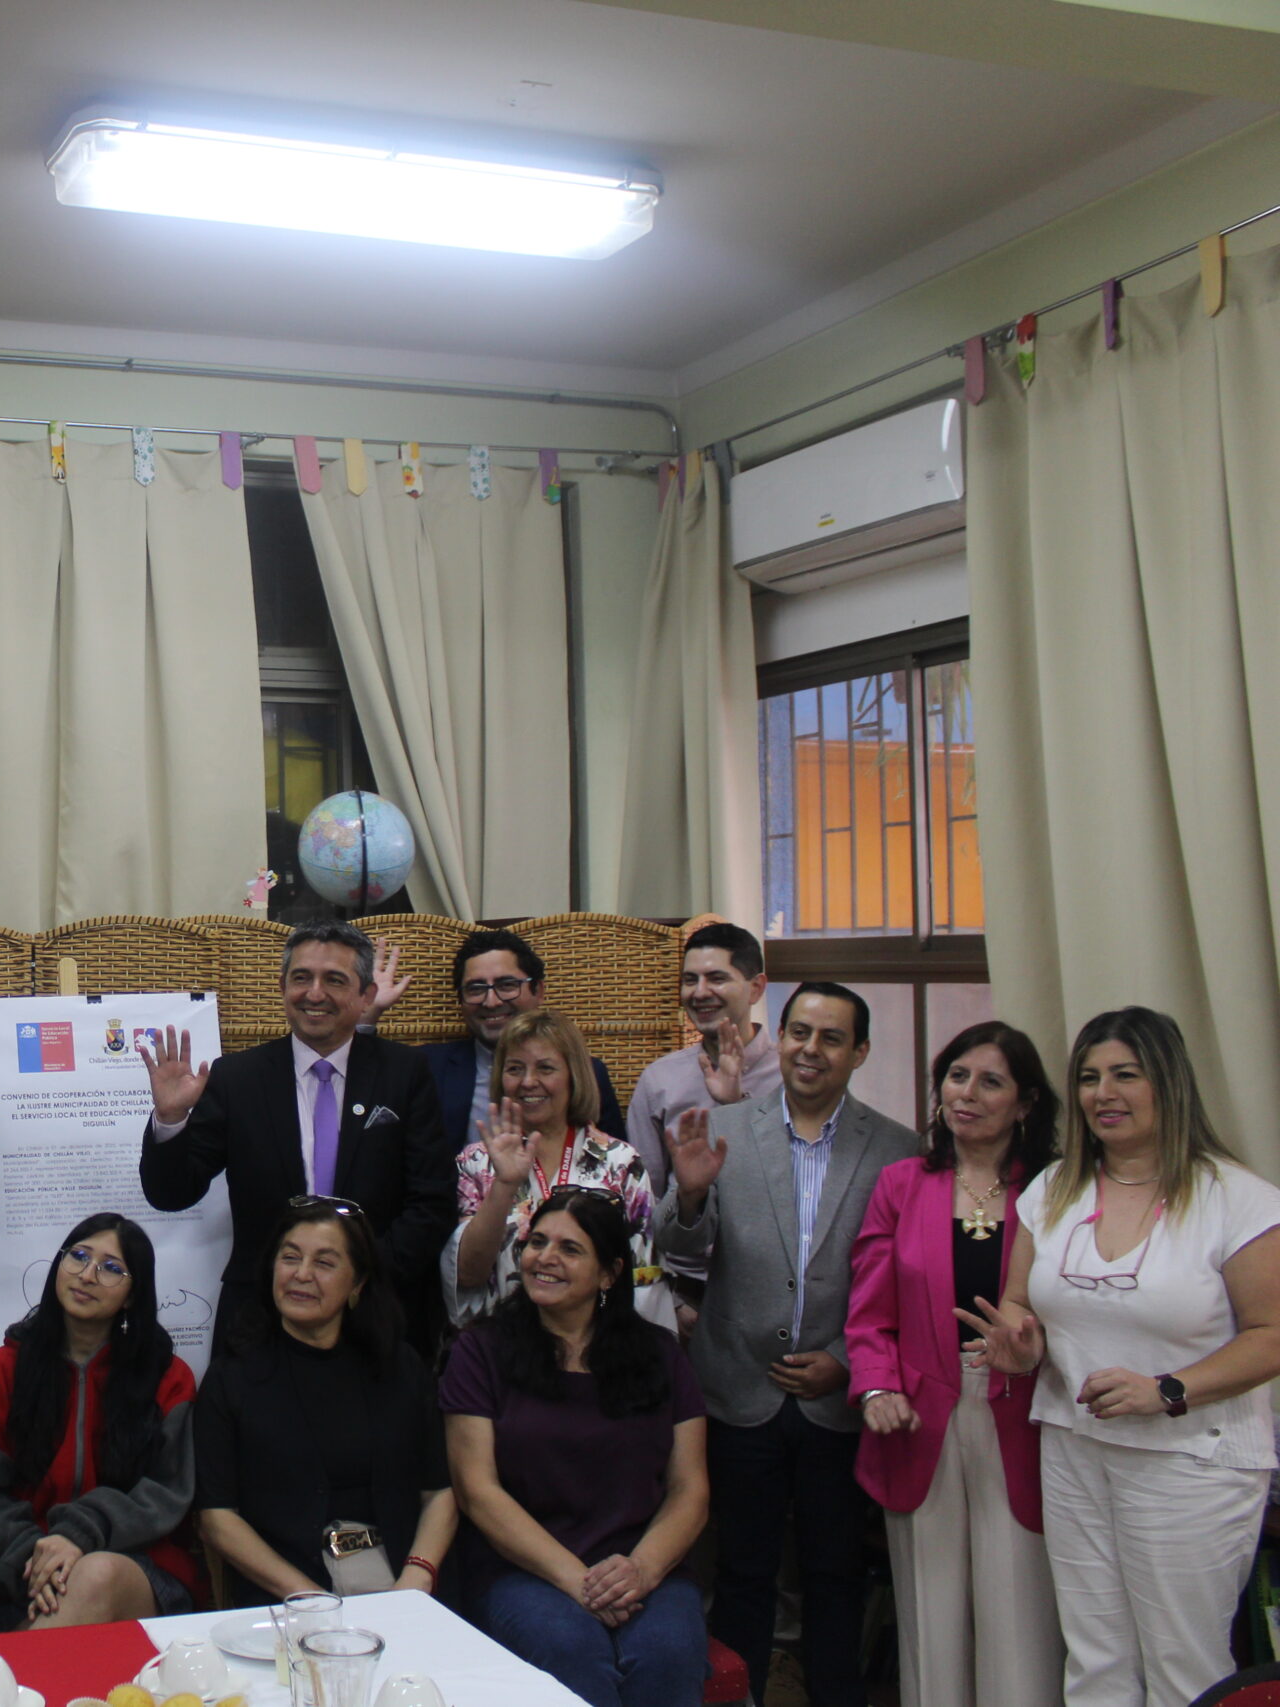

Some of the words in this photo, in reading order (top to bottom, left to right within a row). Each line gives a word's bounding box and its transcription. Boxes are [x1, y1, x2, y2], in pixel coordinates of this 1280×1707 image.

[1, 1093, 40, 1101] CONVENIO
[41, 1092, 50, 1100] DE
[52, 1090, 105, 1099] COOPERACIÓN
[113, 1089, 152, 1097] COLABORA
[27, 1102, 51, 1110] ILUSTRE
[53, 1101, 108, 1109] MUNICIPALIDAD
[121, 1098, 149, 1107] CHILLÁN
[20, 1112, 53, 1120] SERVICIO
[54, 1111, 77, 1119] LOCAL
[89, 1109, 132, 1118] EDUCACIÓN
[134, 1107, 152, 1116] PÚBLI
[83, 1119, 116, 1128] DIGUILLÍN
